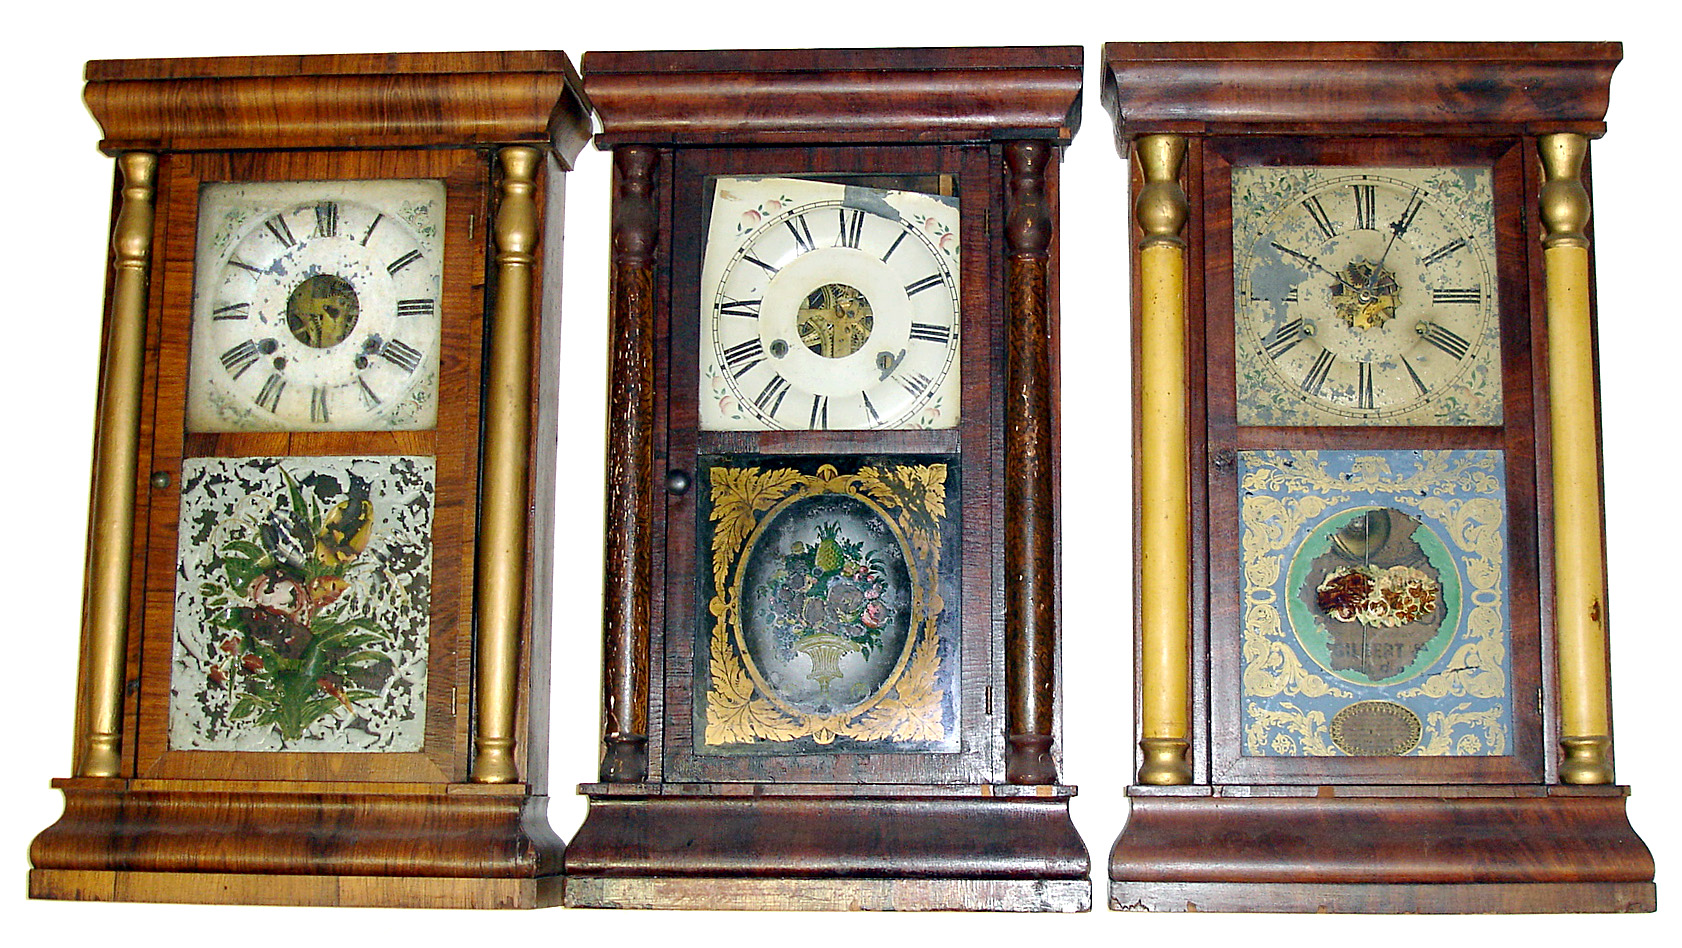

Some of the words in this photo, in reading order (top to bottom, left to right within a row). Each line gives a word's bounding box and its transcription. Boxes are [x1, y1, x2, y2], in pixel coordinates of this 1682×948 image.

[313, 201, 338, 238] XII
[1348, 184, 1379, 232] XII
[1396, 198, 1430, 242] I
[264, 213, 297, 249] XI
[361, 213, 384, 247] I
[783, 212, 820, 257] XI
[831, 208, 866, 251] XII
[880, 230, 911, 264] I
[227, 252, 263, 283] X
[386, 249, 424, 277] II
[741, 244, 783, 283] X
[1421, 236, 1468, 269] II
[904, 267, 946, 300] II
[1432, 284, 1481, 309] III
[213, 302, 250, 321] IX
[397, 299, 434, 317] III
[720, 293, 764, 322] IX
[909, 320, 951, 348] III
[1421, 321, 1472, 366] IIII
[220, 338, 260, 381] VIII
[382, 338, 423, 377] IIII
[721, 334, 768, 386] VIII
[1300, 348, 1338, 396] VII
[1400, 353, 1428, 399] V
[255, 373, 287, 413] VII
[311, 385, 329, 423] VI
[358, 375, 381, 412] V
[749, 371, 792, 423] VII
[1352, 361, 1381, 411] VI
[809, 393, 829, 430] VI
[861, 390, 888, 429] V
